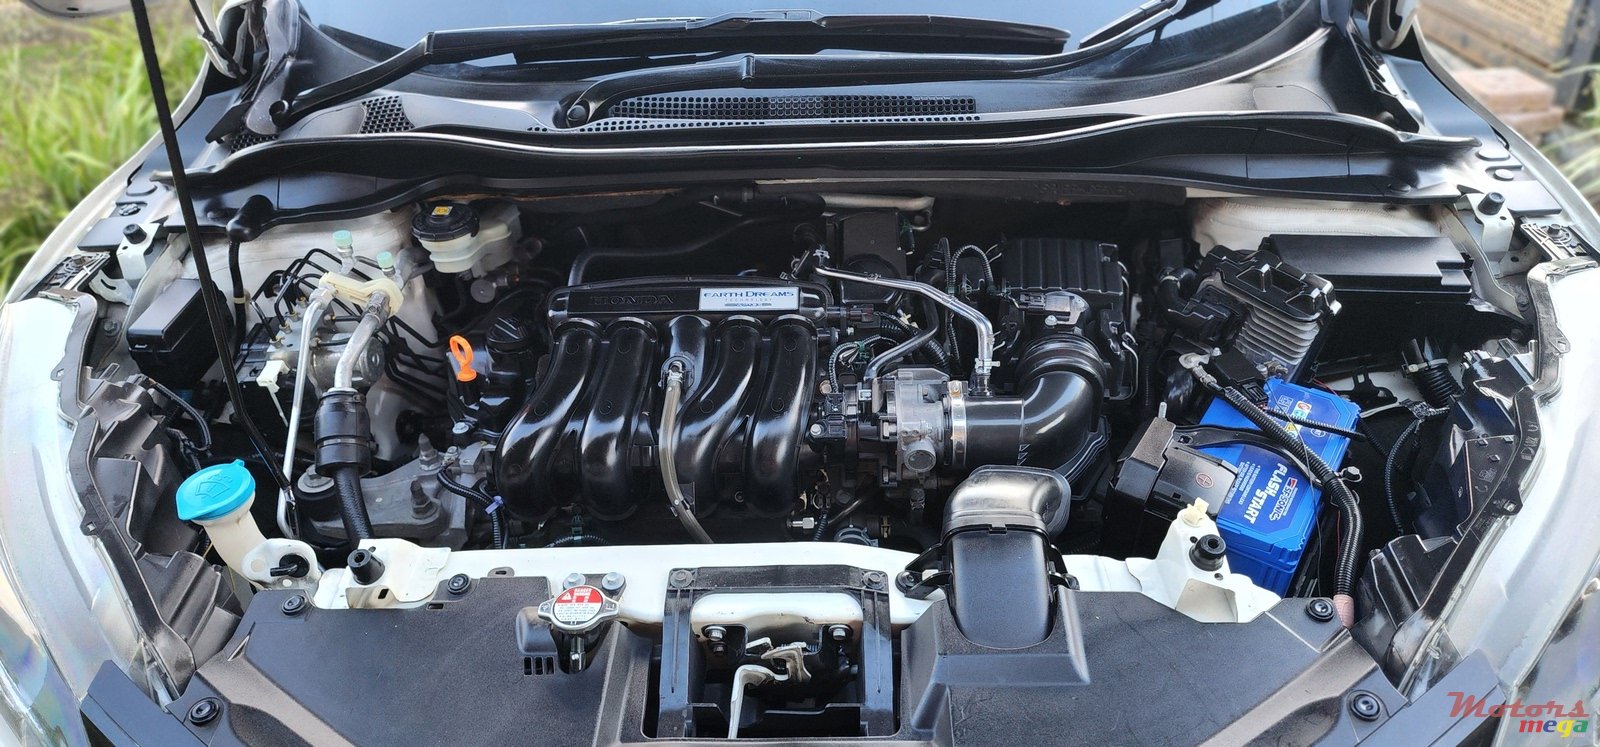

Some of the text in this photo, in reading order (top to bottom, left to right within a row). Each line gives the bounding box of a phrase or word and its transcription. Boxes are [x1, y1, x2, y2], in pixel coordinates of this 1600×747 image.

[745, 290, 794, 298] DREAMS
[1244, 463, 1288, 525] FLASH START
